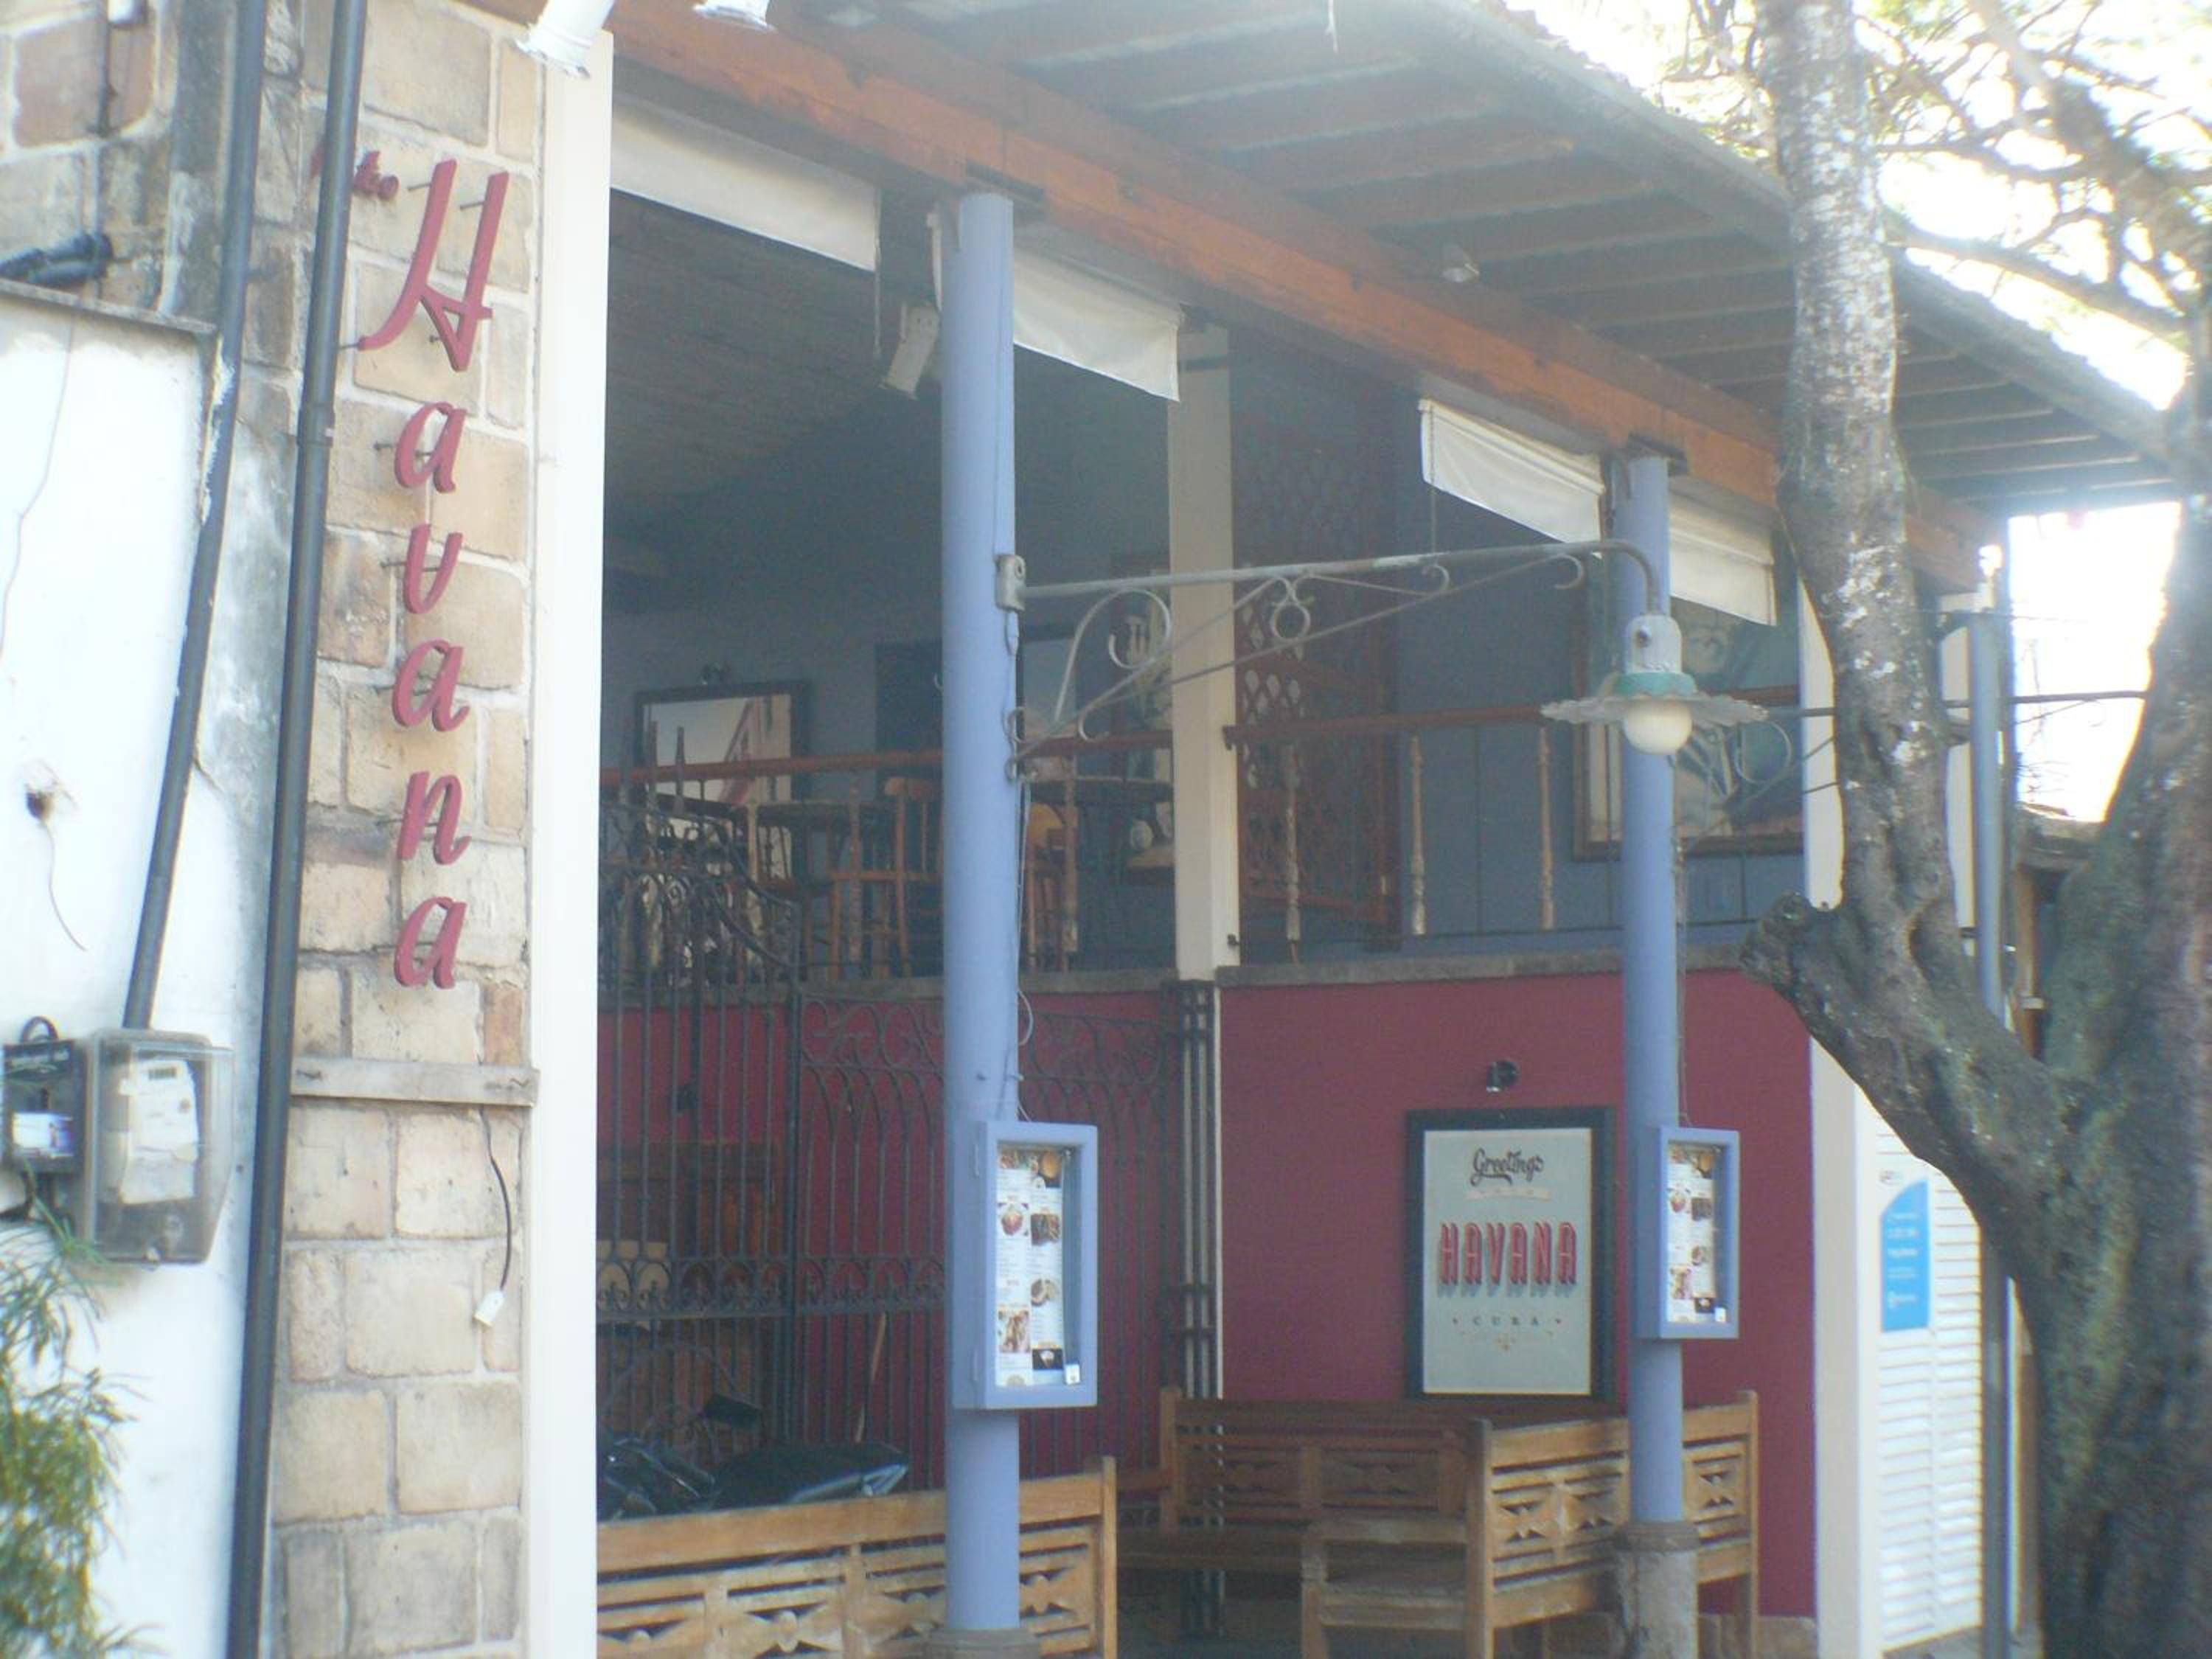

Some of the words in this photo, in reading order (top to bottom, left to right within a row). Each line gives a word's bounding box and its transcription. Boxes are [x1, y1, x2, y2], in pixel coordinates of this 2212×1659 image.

[356, 157, 509, 990] Havana
[1470, 1147, 1545, 1186] Greetings
[1439, 1221, 1577, 1287] HAVANA
